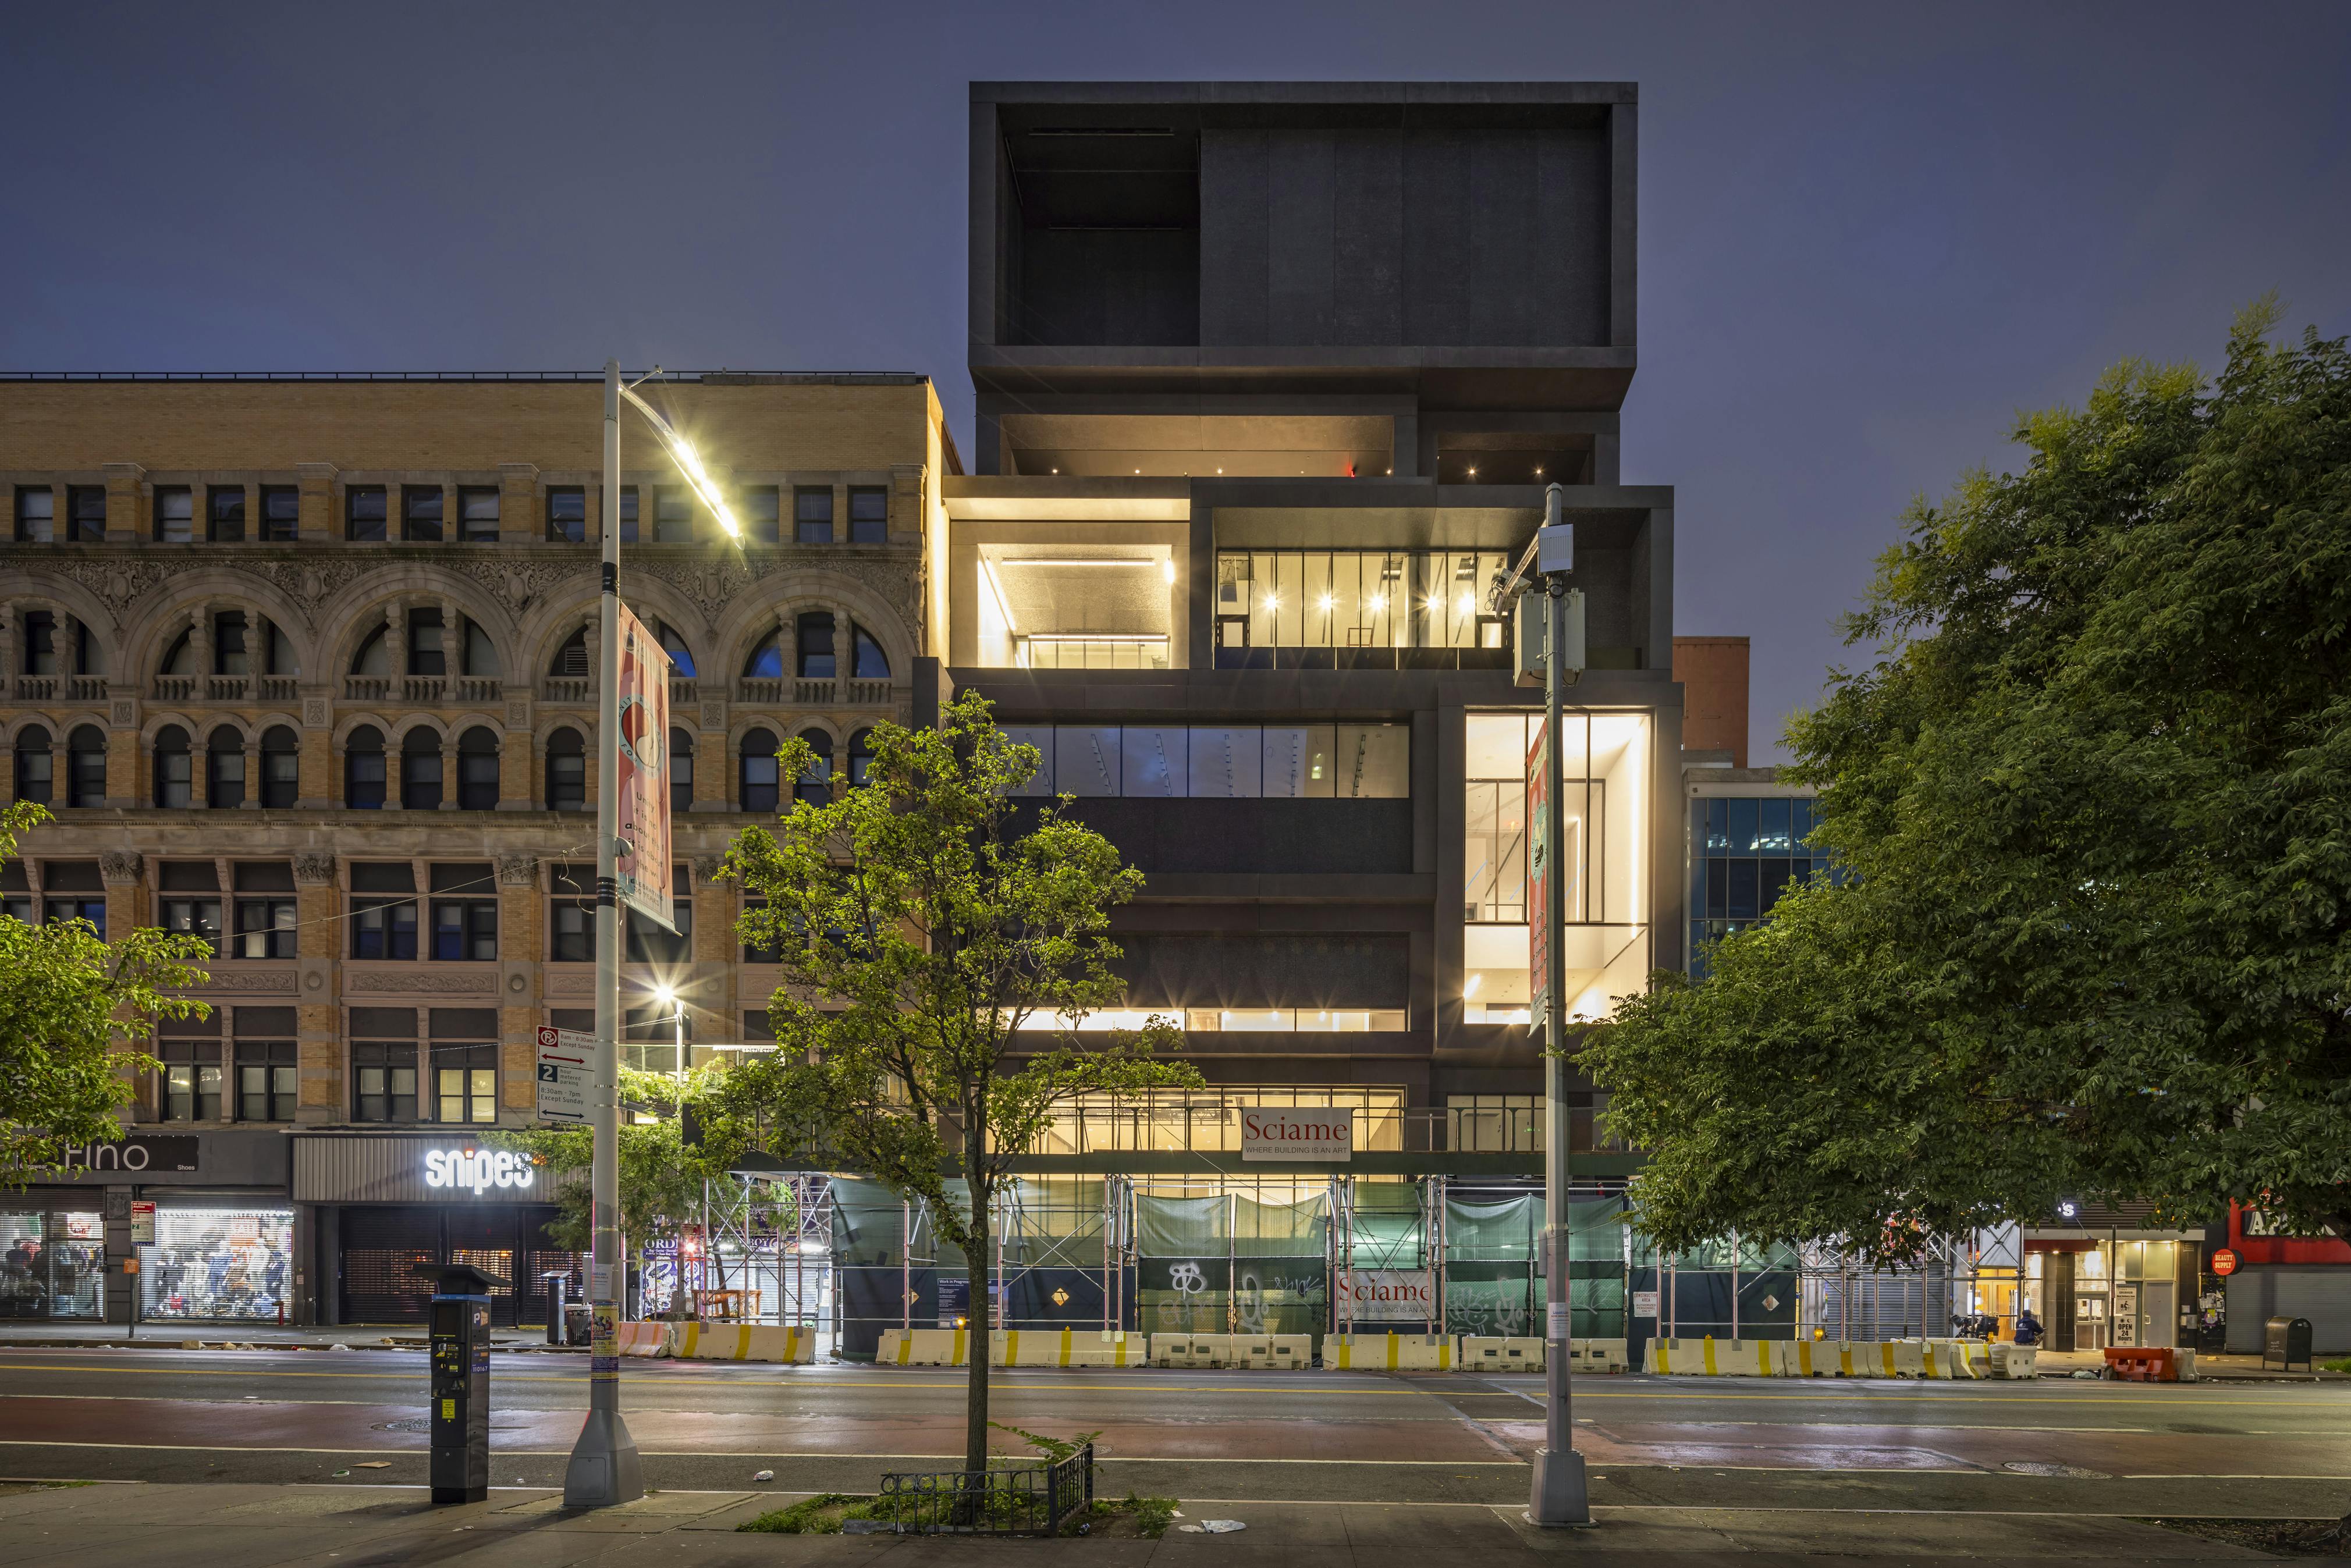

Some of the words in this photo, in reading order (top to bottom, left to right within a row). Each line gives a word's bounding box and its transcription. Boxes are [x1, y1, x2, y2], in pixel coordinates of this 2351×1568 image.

[641, 810, 647, 820] is
[625, 821, 650, 841] about
[638, 841, 644, 852] is
[647, 850, 663, 868] about
[637, 859, 648, 872] the
[578, 1043, 595, 1051] Sunday
[542, 1065, 553, 1081] 2
[1246, 1114, 1348, 1140] Sciame
[426, 1149, 533, 1194] snipes
[1339, 1277, 1429, 1301] Sciame
